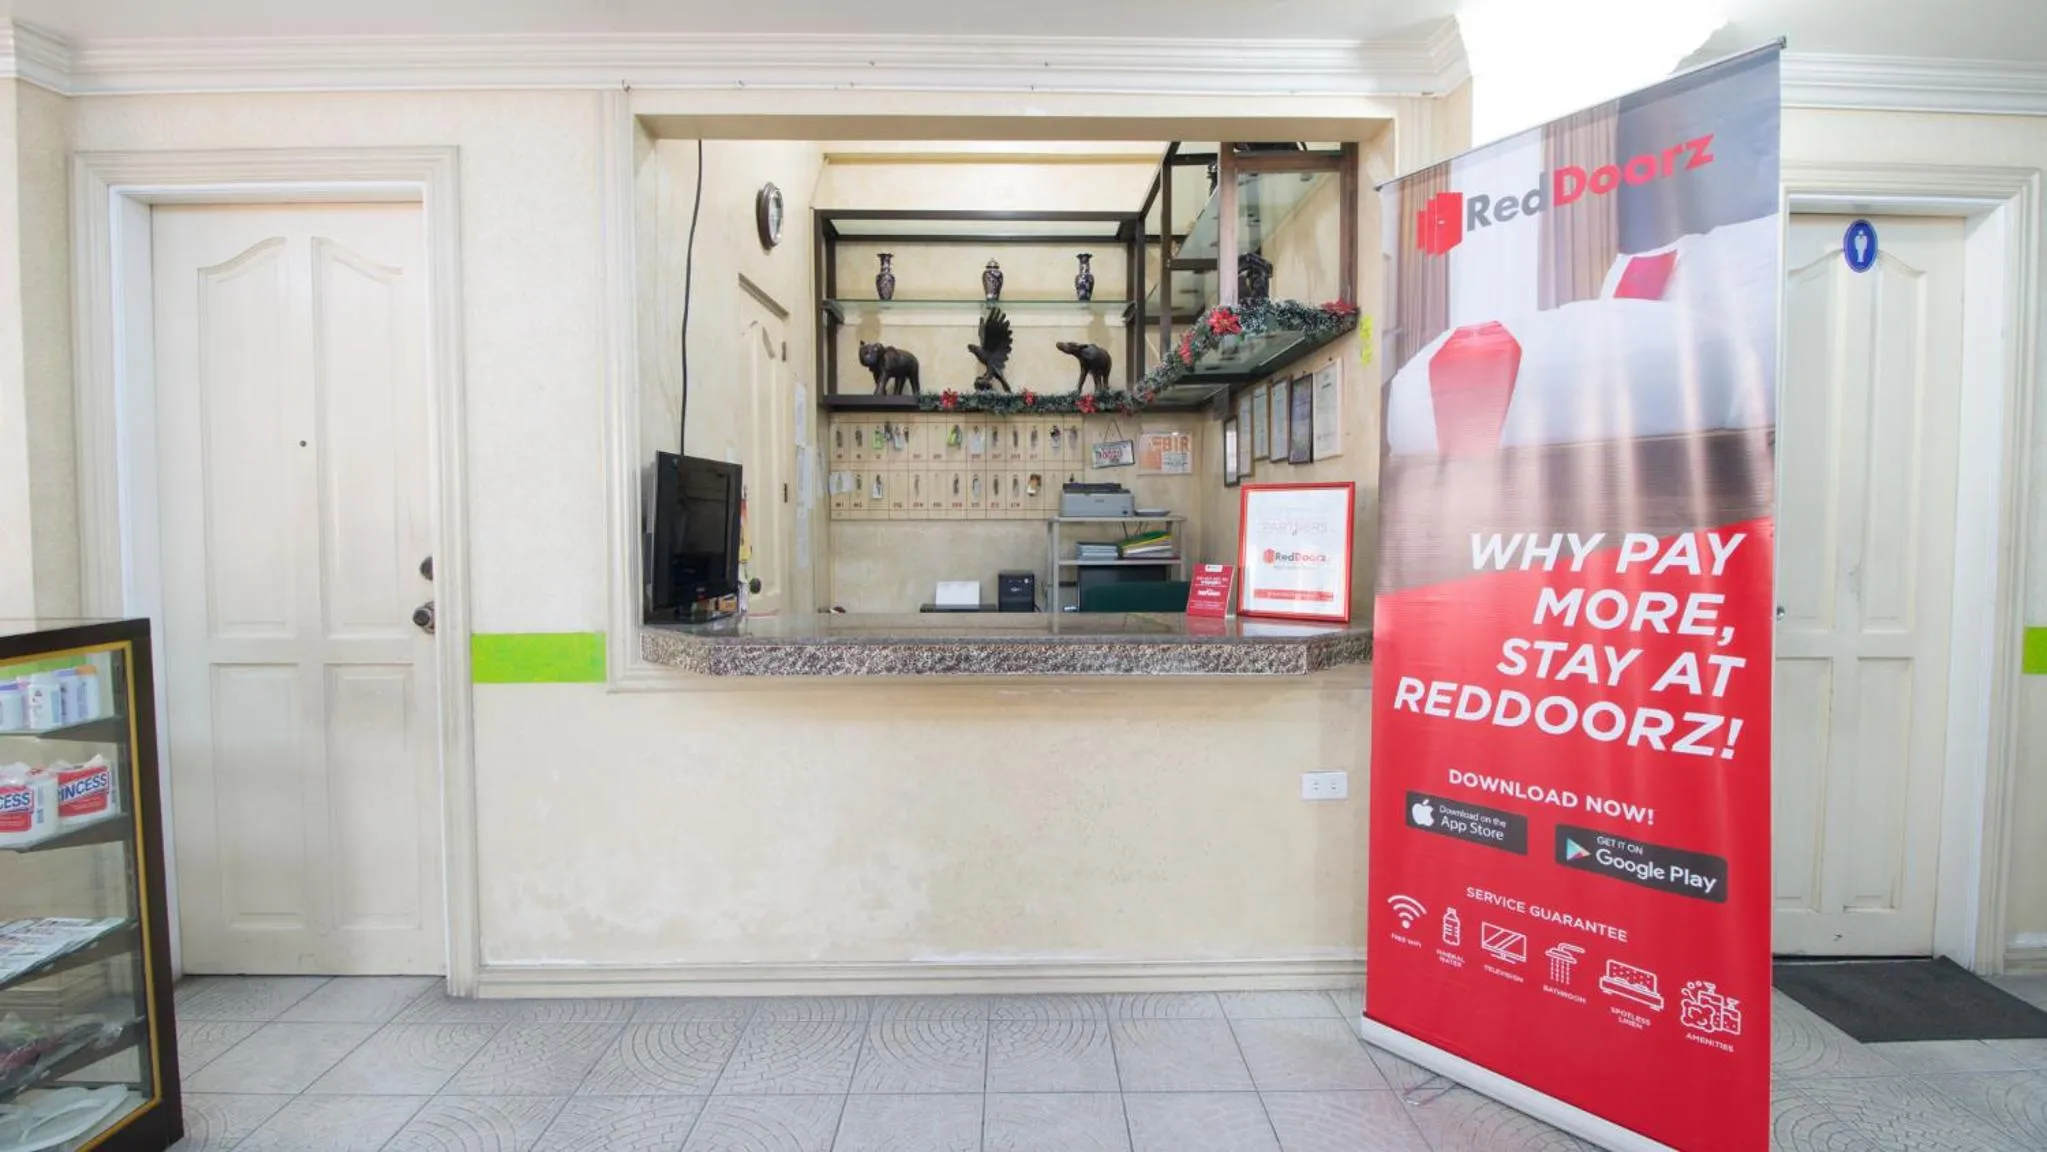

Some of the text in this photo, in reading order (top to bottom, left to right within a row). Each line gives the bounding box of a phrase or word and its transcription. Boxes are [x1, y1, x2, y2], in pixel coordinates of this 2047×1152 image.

[1467, 133, 1715, 233] RedDoorz
[1469, 532, 1748, 576] WHY PAY
[1532, 587, 1737, 647] MORE,
[1496, 638, 1748, 698] STAY AT
[1393, 677, 1744, 760] REDDOORZ!
[57, 773, 108, 802] INCESS
[1448, 769, 1655, 825] DOWNLOAD NOW!
[1439, 804, 1507, 828] Download on the
[1441, 815, 1504, 841] App Store
[1597, 836, 1644, 855] GET IT ON
[1596, 848, 1717, 893] Google Play
[1466, 886, 1628, 943] SERVICE GUARANTEE
[1542, 984, 1587, 1004] BATHROOM
[1610, 1006, 1651, 1026] SPOTLESS
[1618, 1016, 1643, 1030] LINEN
[1686, 1032, 1734, 1053] AMENITIES
